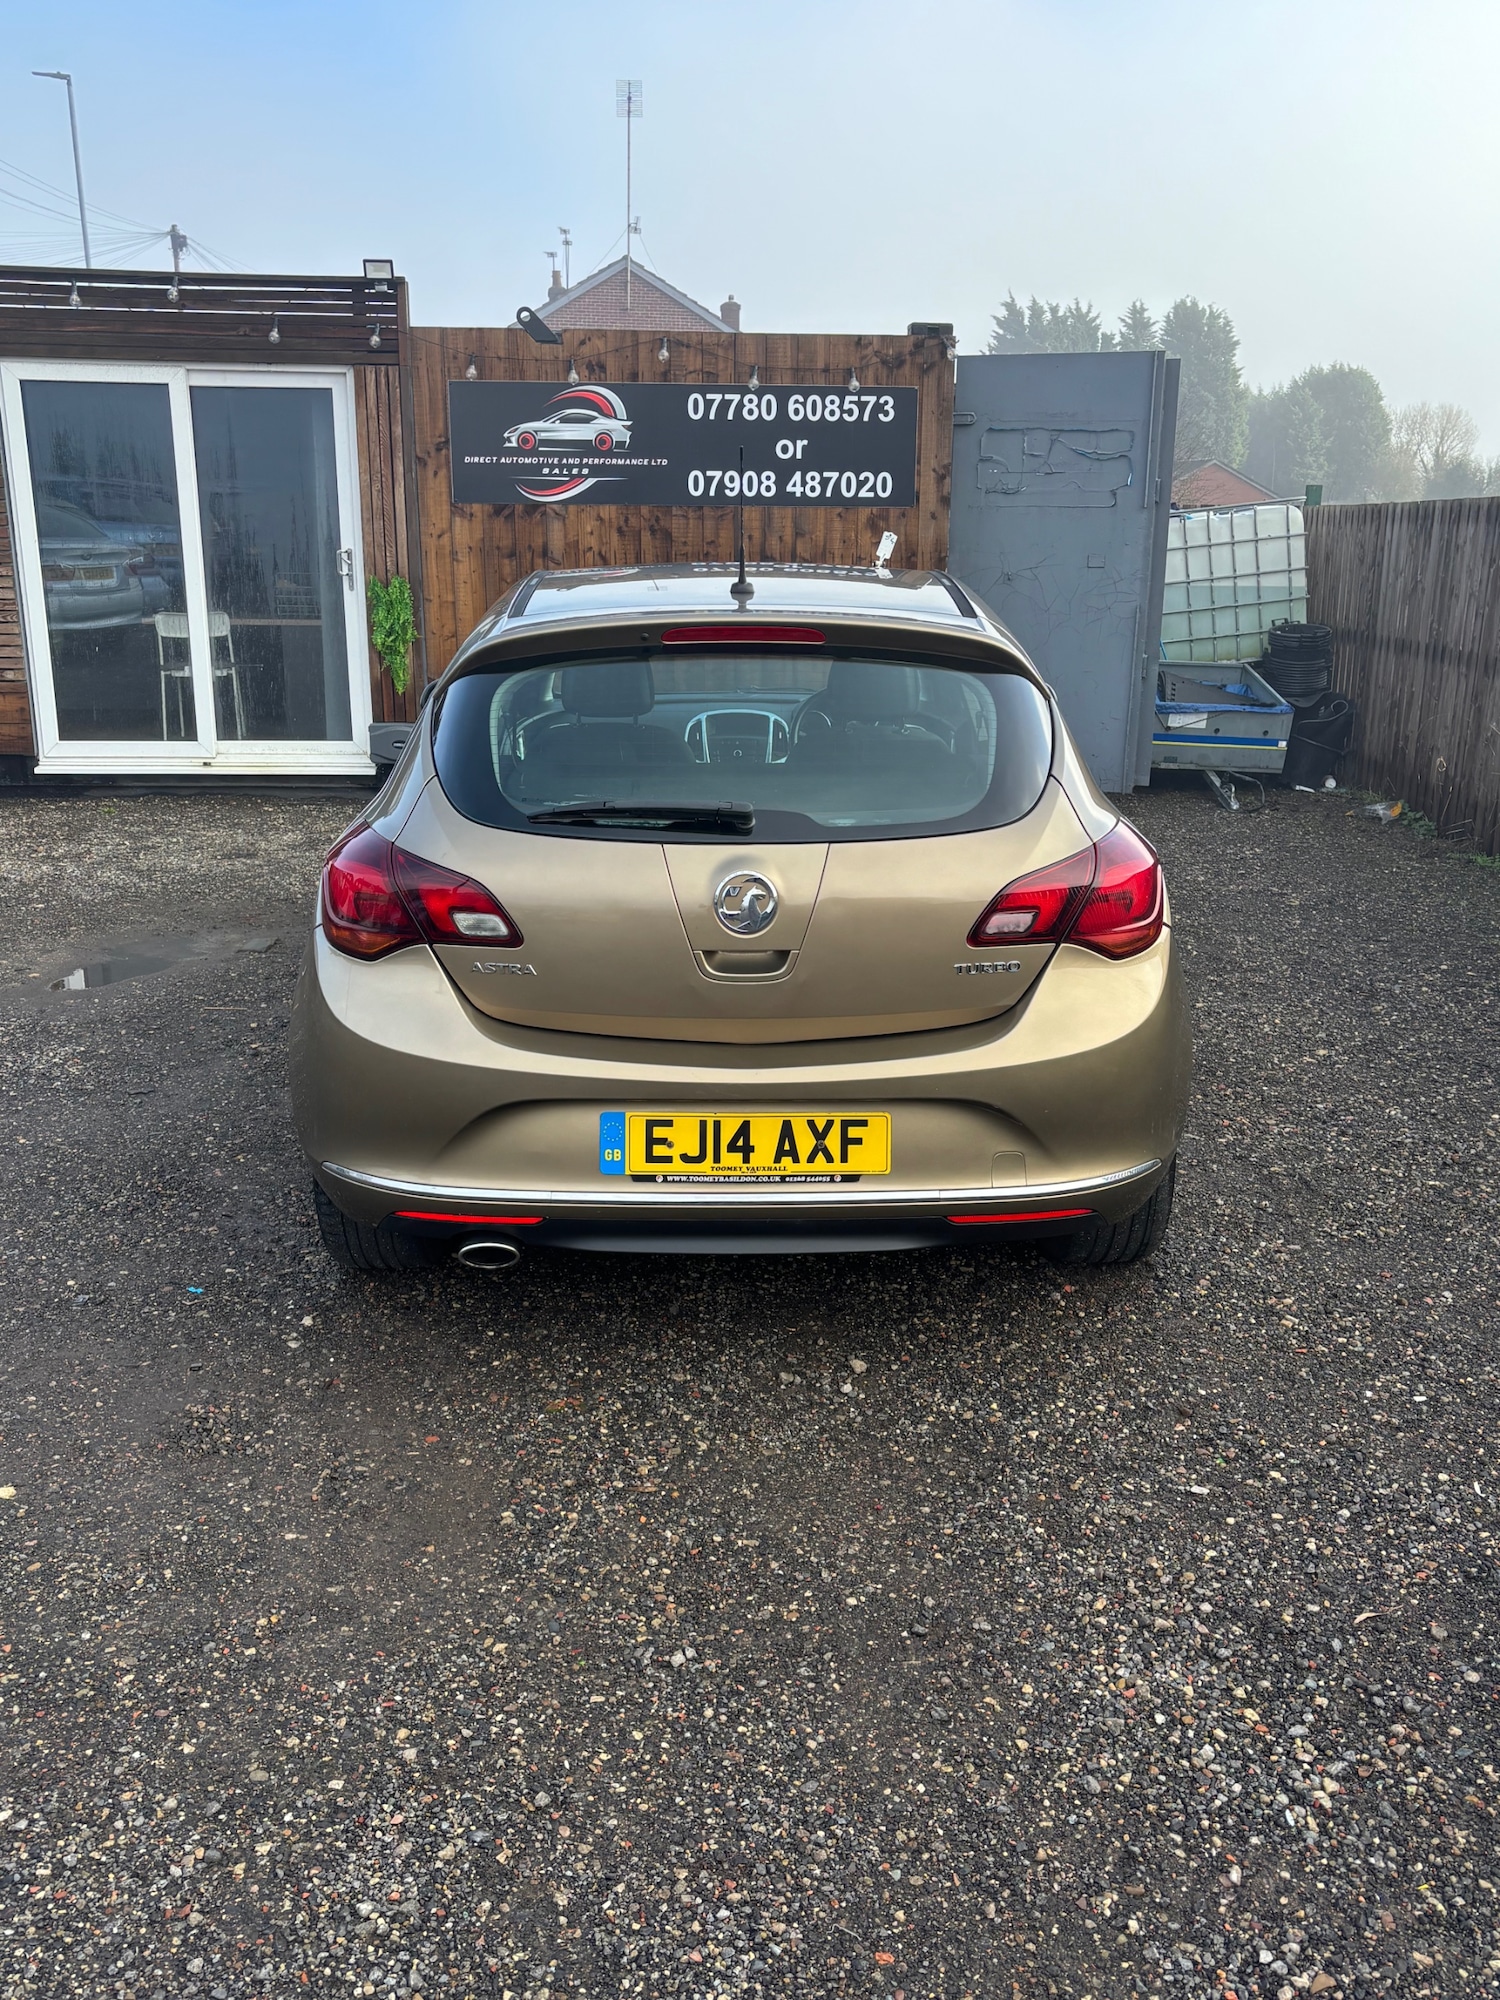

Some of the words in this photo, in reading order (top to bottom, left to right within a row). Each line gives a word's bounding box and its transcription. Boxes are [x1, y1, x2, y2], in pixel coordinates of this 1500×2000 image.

[687, 393, 777, 421] 07780
[788, 394, 895, 422] 608573
[775, 438, 808, 460] or
[464, 456, 498, 464] DIRECT
[500, 456, 559, 464] AUTOMOTIVE
[542, 467, 590, 475] SALES
[688, 470, 776, 497] 07908
[786, 471, 893, 498] 487020
[471, 962, 538, 976] ASTRA
[953, 960, 1021, 975] TURBO
[645, 1119, 755, 1164] EJ14
[773, 1119, 868, 1164] AXF
[604, 1149, 622, 1161] GB
